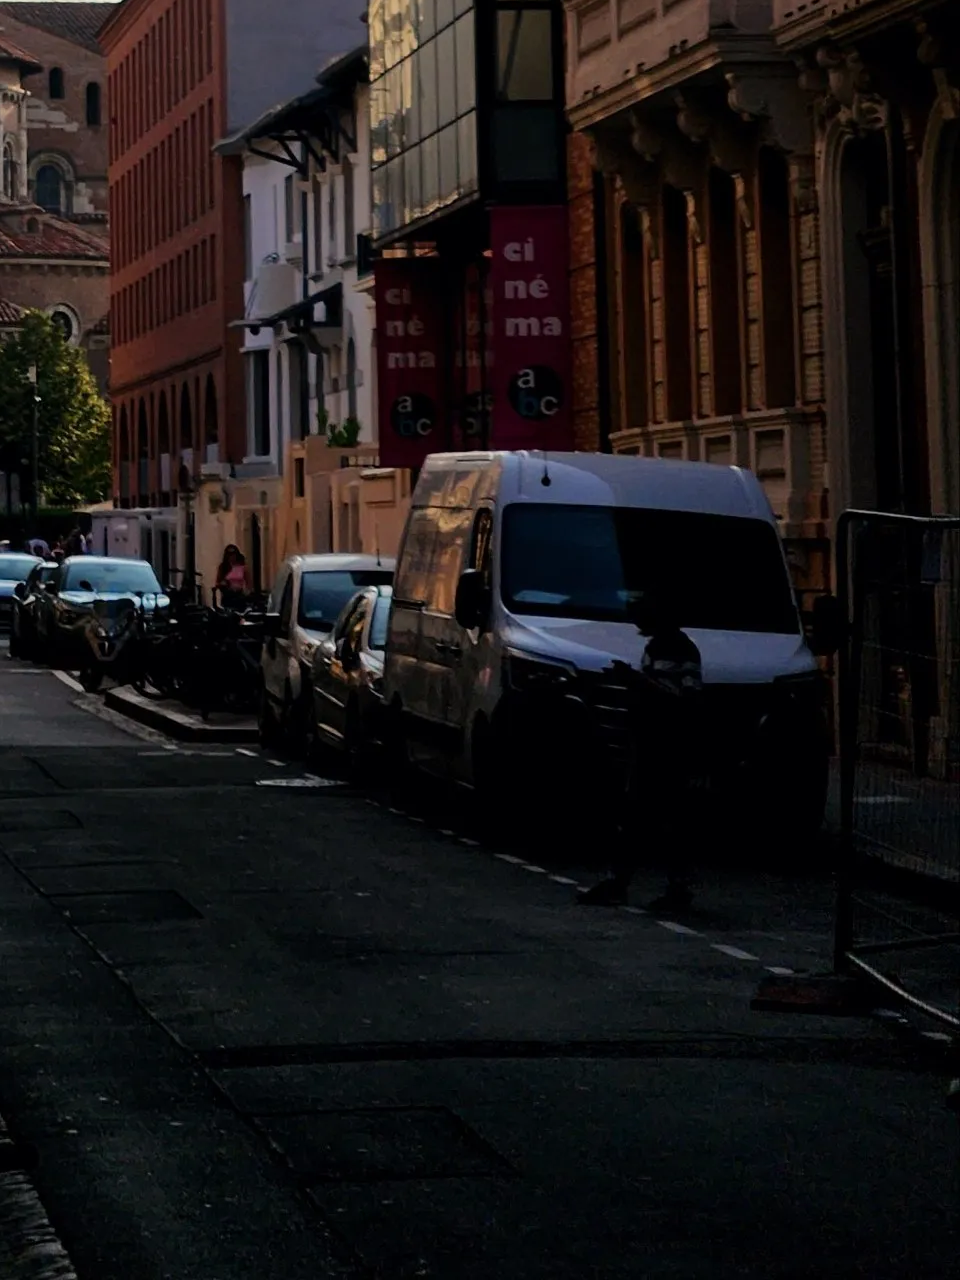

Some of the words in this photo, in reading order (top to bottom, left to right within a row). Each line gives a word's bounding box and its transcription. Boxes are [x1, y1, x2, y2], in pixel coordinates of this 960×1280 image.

[503, 236, 535, 262] ci
[504, 273, 550, 299] né
[504, 315, 562, 337] ma
[387, 350, 436, 369] ma
